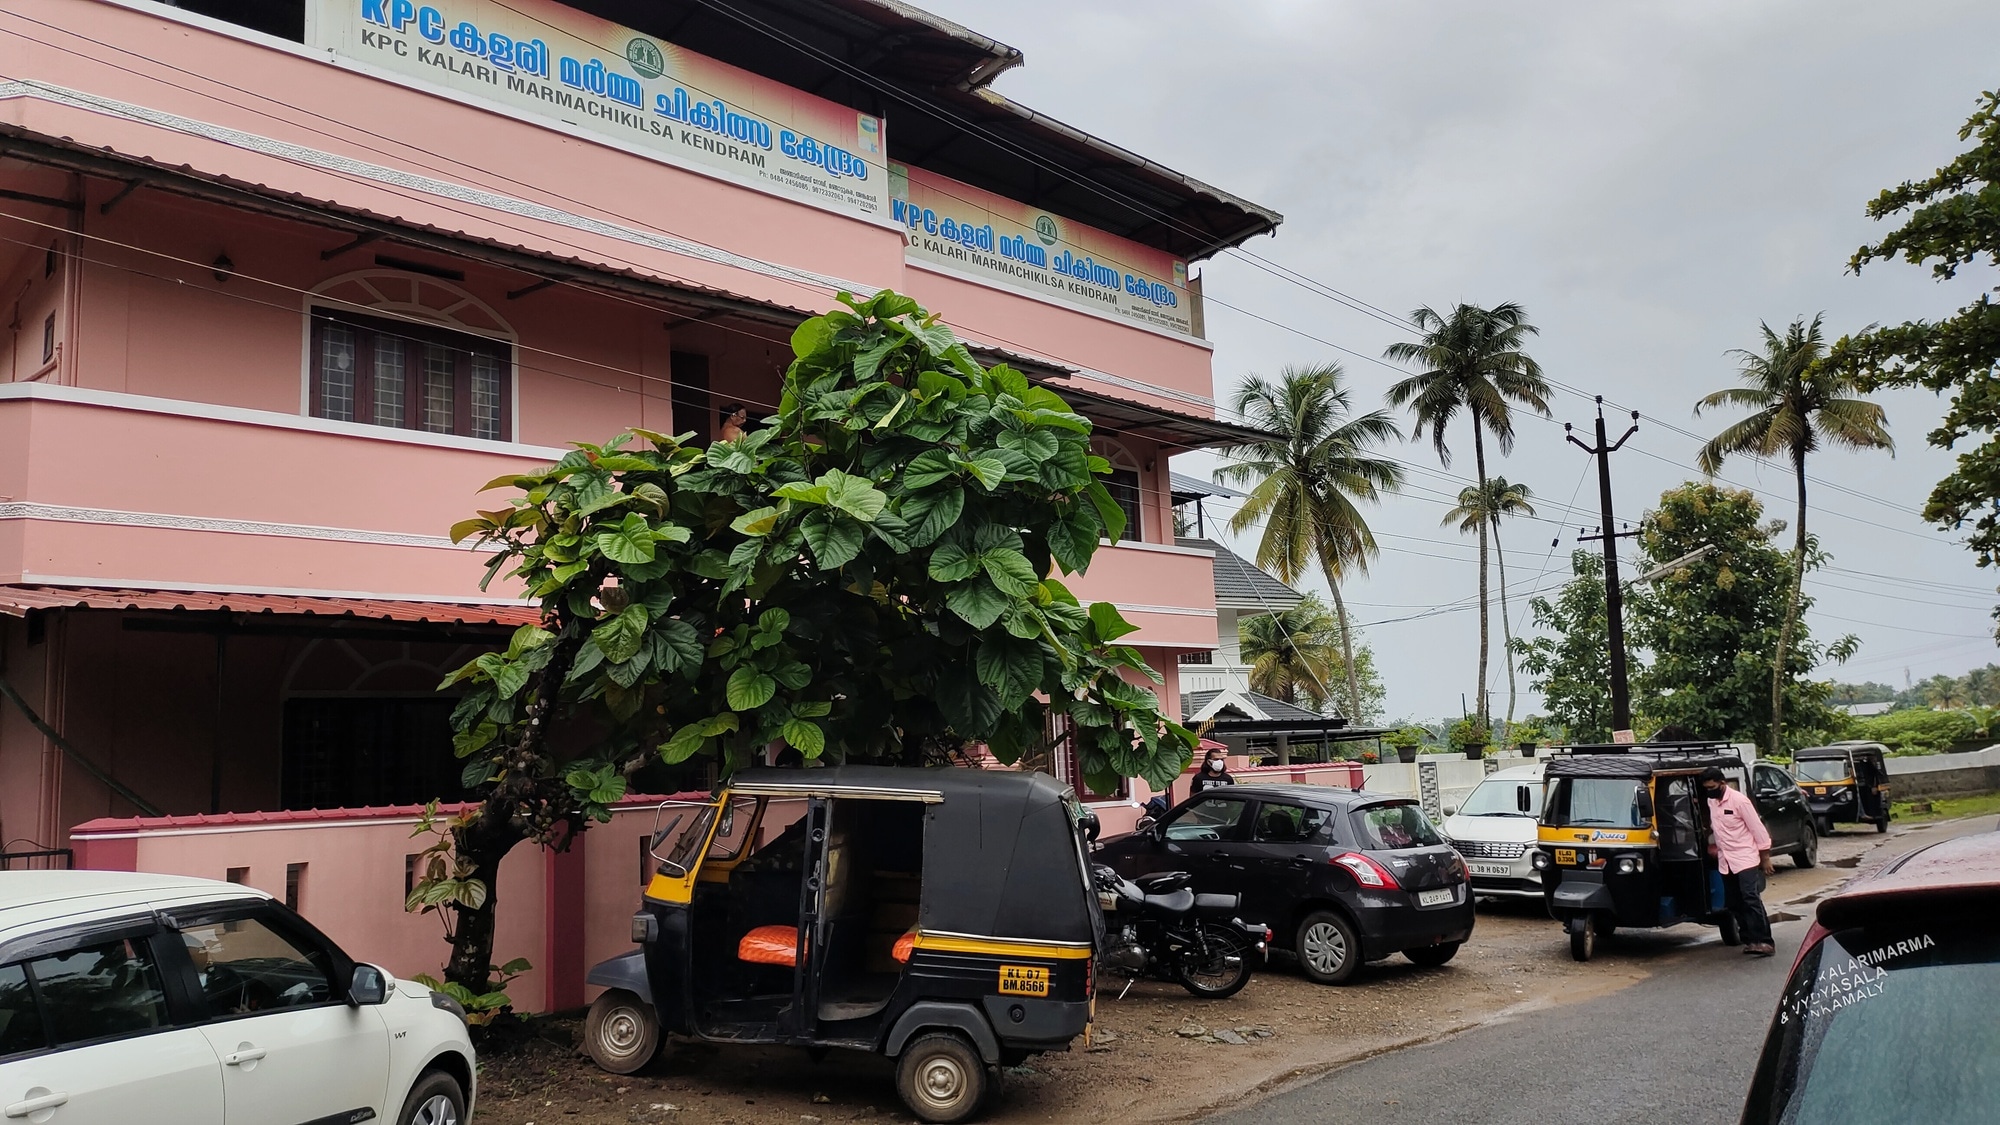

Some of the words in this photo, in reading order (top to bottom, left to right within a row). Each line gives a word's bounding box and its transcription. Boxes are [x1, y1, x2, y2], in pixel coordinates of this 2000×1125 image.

[361, 0, 445, 44] KPC
[361, 28, 408, 58] KPC
[417, 46, 498, 86] KALARI
[507, 75, 674, 140] MARMACHIKILSA
[681, 130, 766, 169] KENDRAM
[891, 198, 938, 236] KPC
[923, 238, 968, 262] KALARI
[972, 253, 1066, 291] MARMACHIKILSA
[1068, 282, 1118, 306] KENDRAM
[1477, 864, 1485, 873] 38
[1492, 866, 1509, 874] 0697
[1819, 934, 1936, 981] KALARIMARMA
[1003, 979, 1045, 993] BM.8568
[1780, 1011, 1789, 1025] &
